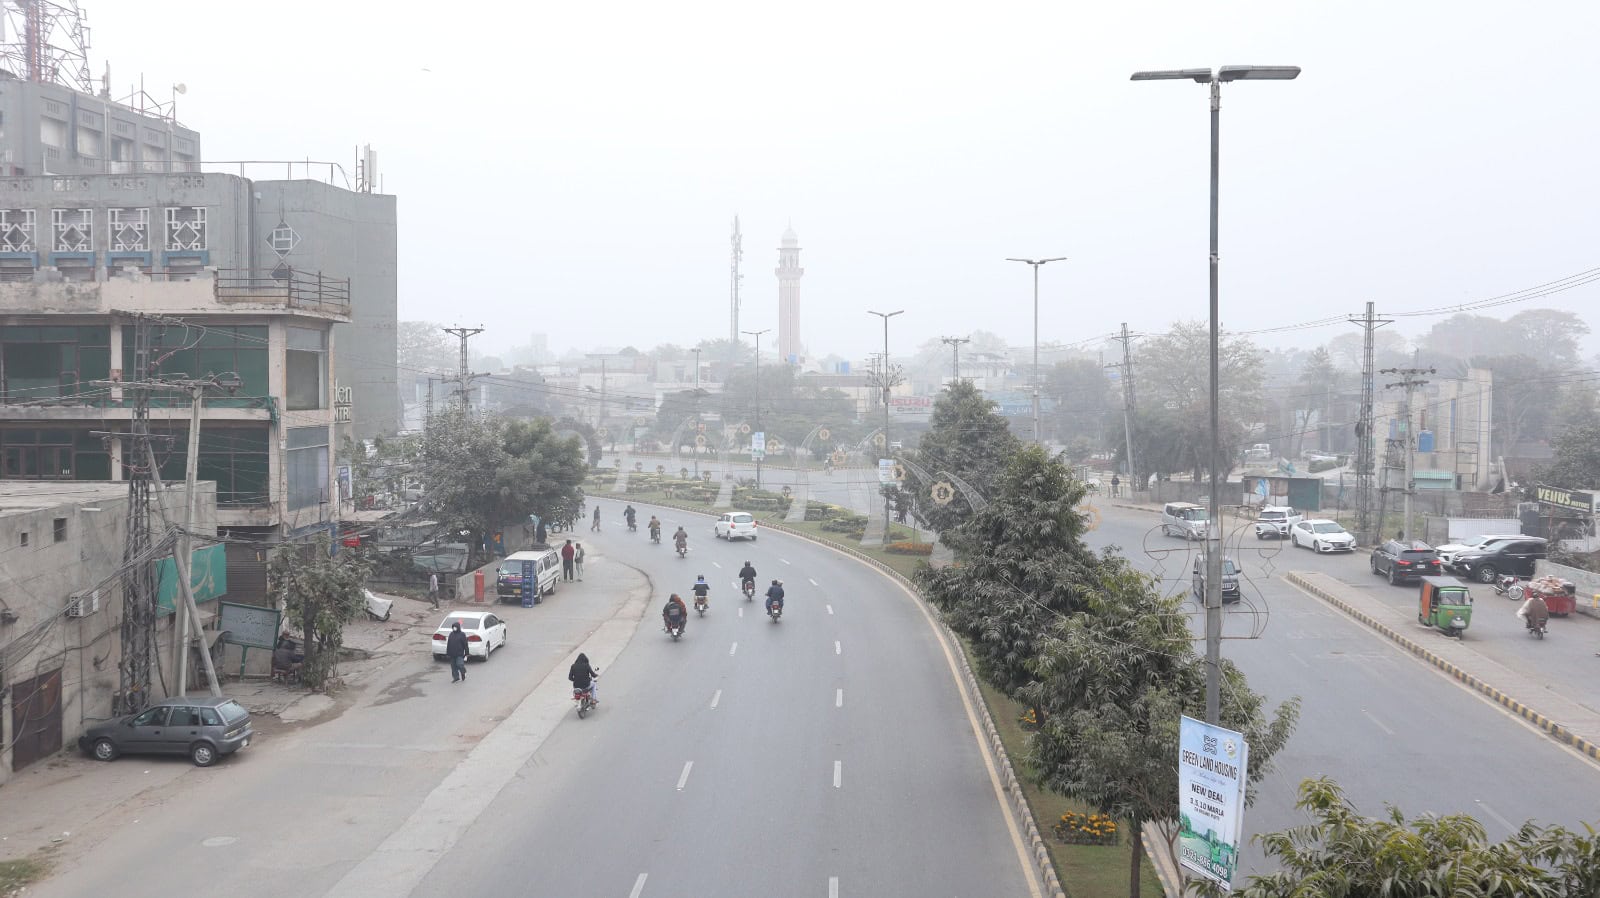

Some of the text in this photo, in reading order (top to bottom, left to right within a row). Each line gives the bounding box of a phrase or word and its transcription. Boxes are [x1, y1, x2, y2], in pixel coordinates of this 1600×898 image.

[1182, 749, 1199, 768] GREEN
[1199, 756, 1213, 772] LAND
[1214, 761, 1238, 780] HOUSING
[1191, 783, 1224, 803] NEW DEAL
[1206, 804, 1224, 817] MARLA
